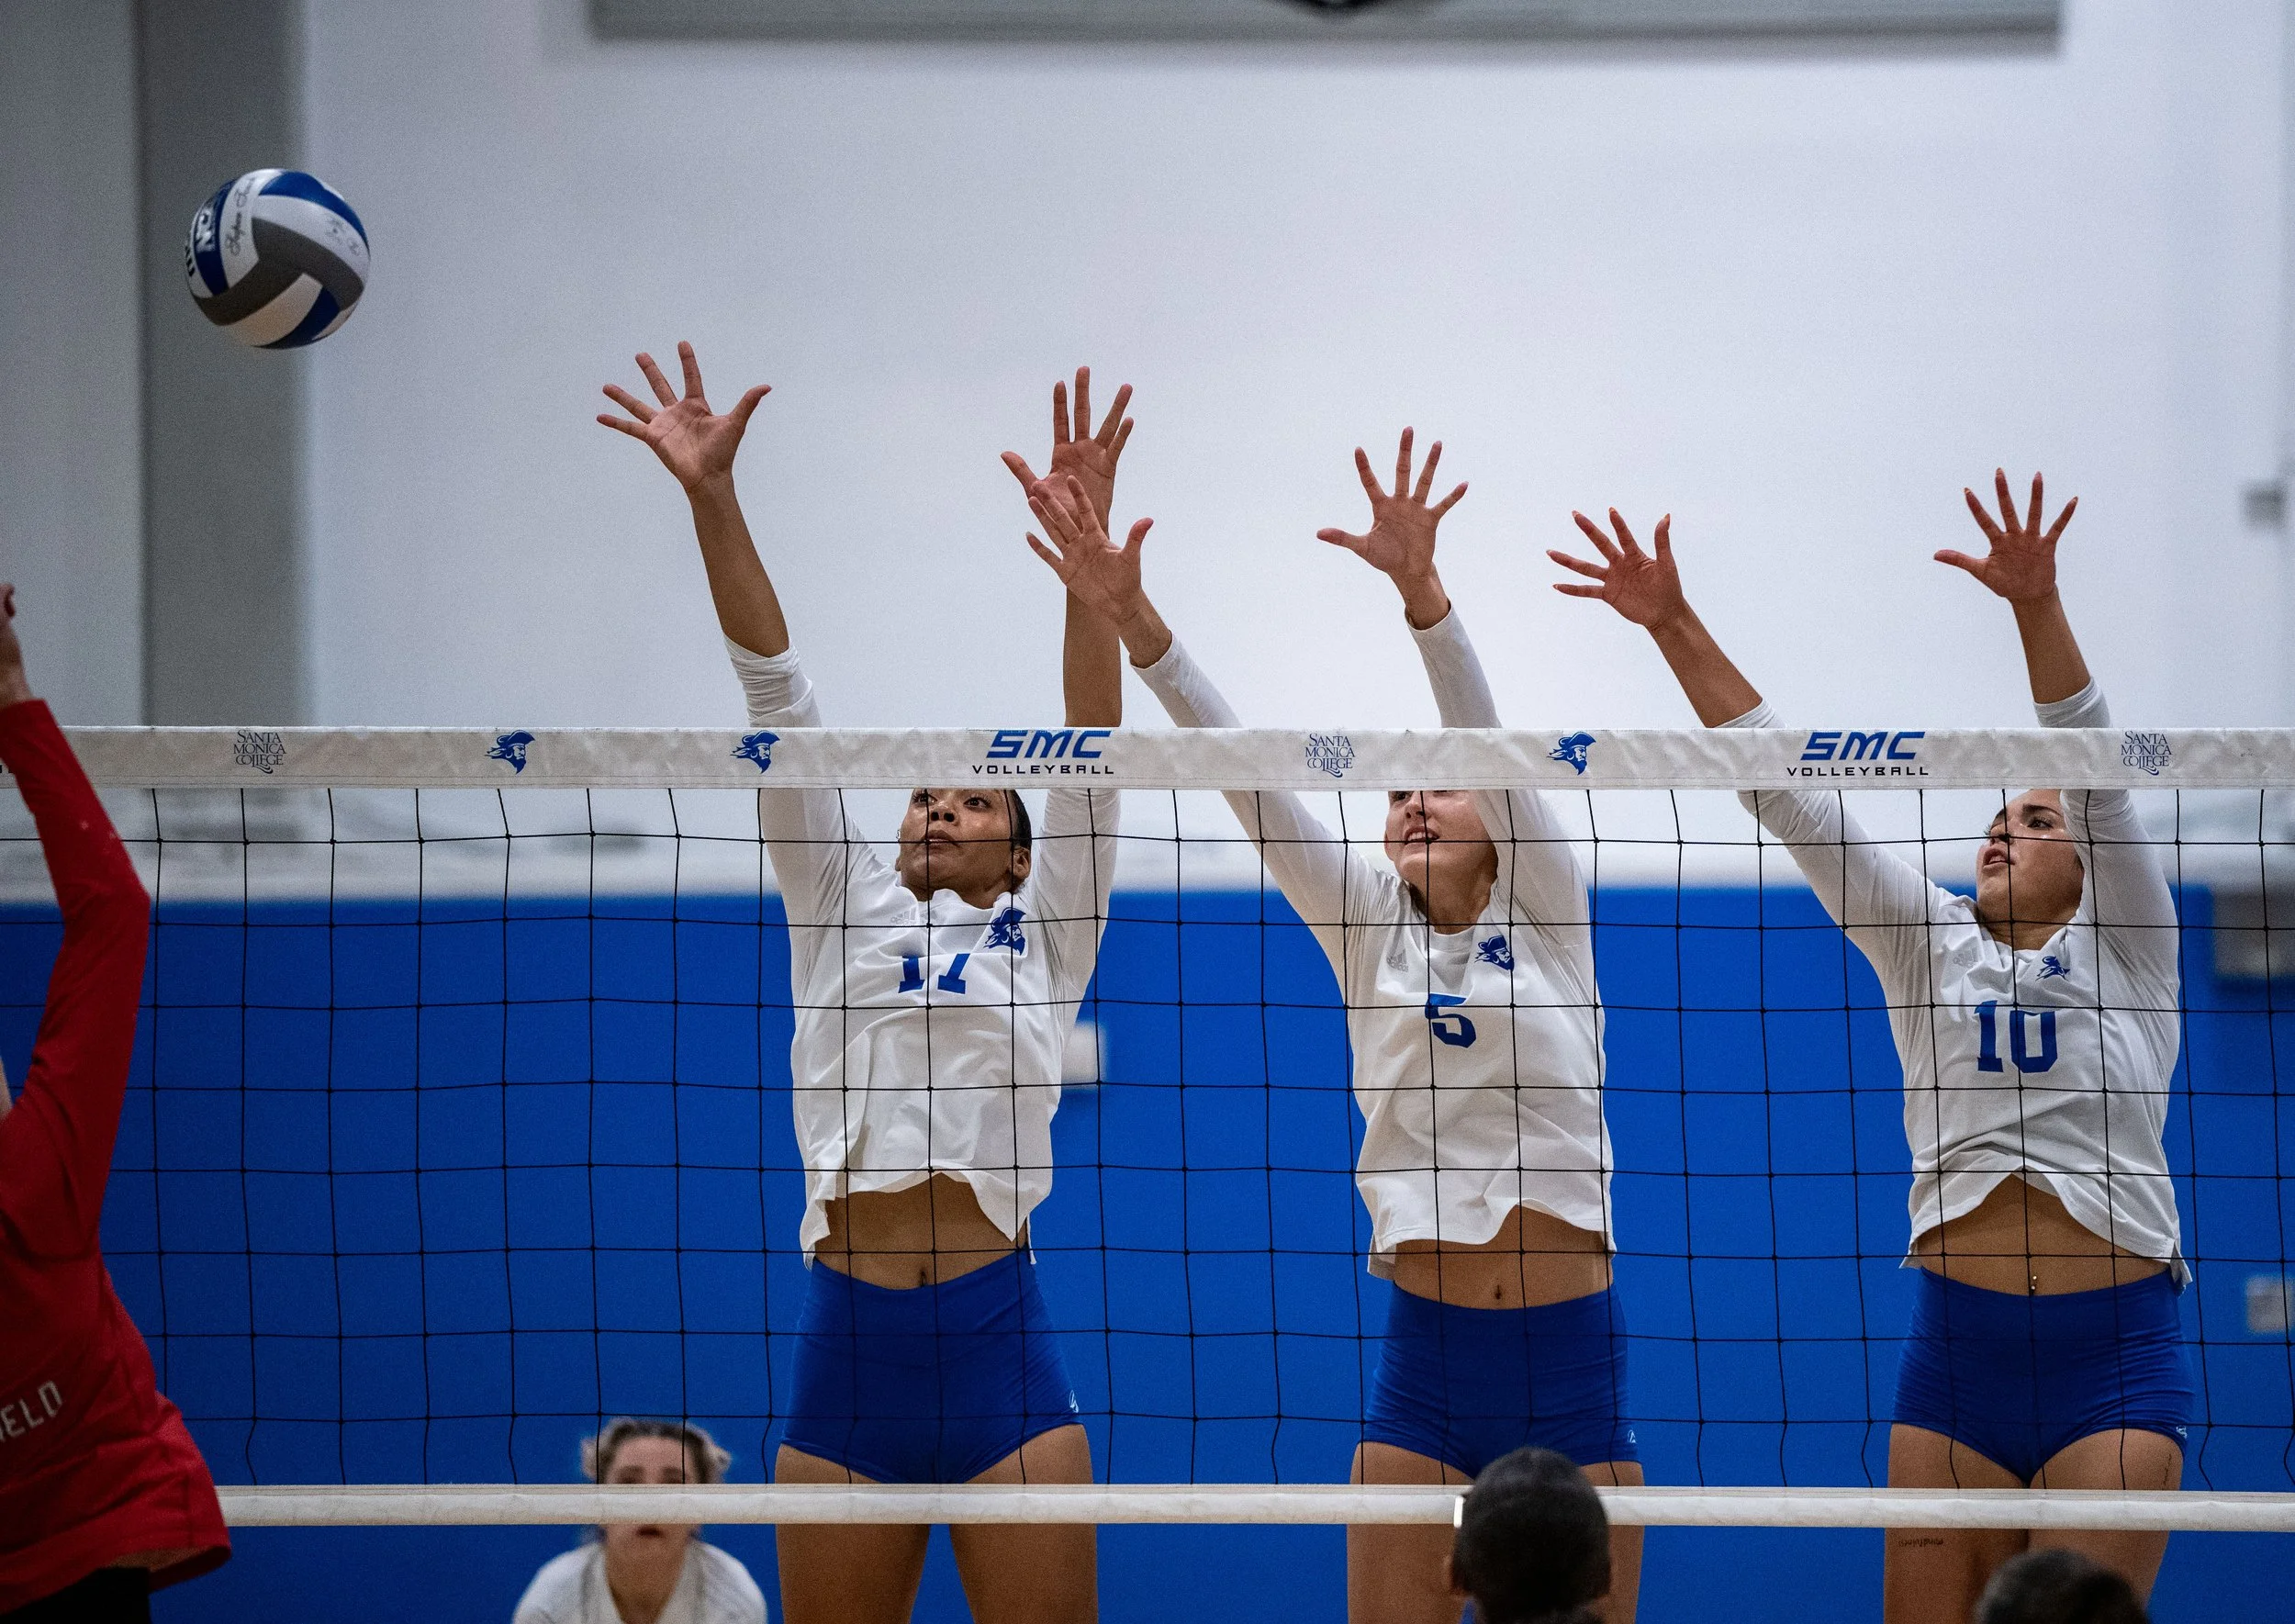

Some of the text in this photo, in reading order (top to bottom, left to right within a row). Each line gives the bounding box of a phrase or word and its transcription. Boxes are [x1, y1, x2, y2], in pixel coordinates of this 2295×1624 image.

[237, 730, 282, 743] SANTA
[1309, 734, 1350, 746] SANTA
[2125, 731, 2167, 744] SANTA
[233, 744, 286, 754] MONICA
[986, 730, 1112, 758] SMC
[1800, 732, 1925, 760] SMC
[2121, 745, 2172, 755] MONICA
[1305, 747, 1355, 757] MONICA
[236, 755, 284, 774] COLLEGE
[972, 765, 1114, 774] VOLLEYBALL
[1307, 758, 1353, 778] COLLEGE
[2123, 756, 2169, 776] COLLEGE
[1787, 767, 1929, 776] VOLLEYBALL
[1425, 992, 1476, 1048] 5
[1974, 1001, 2058, 1073] 10
